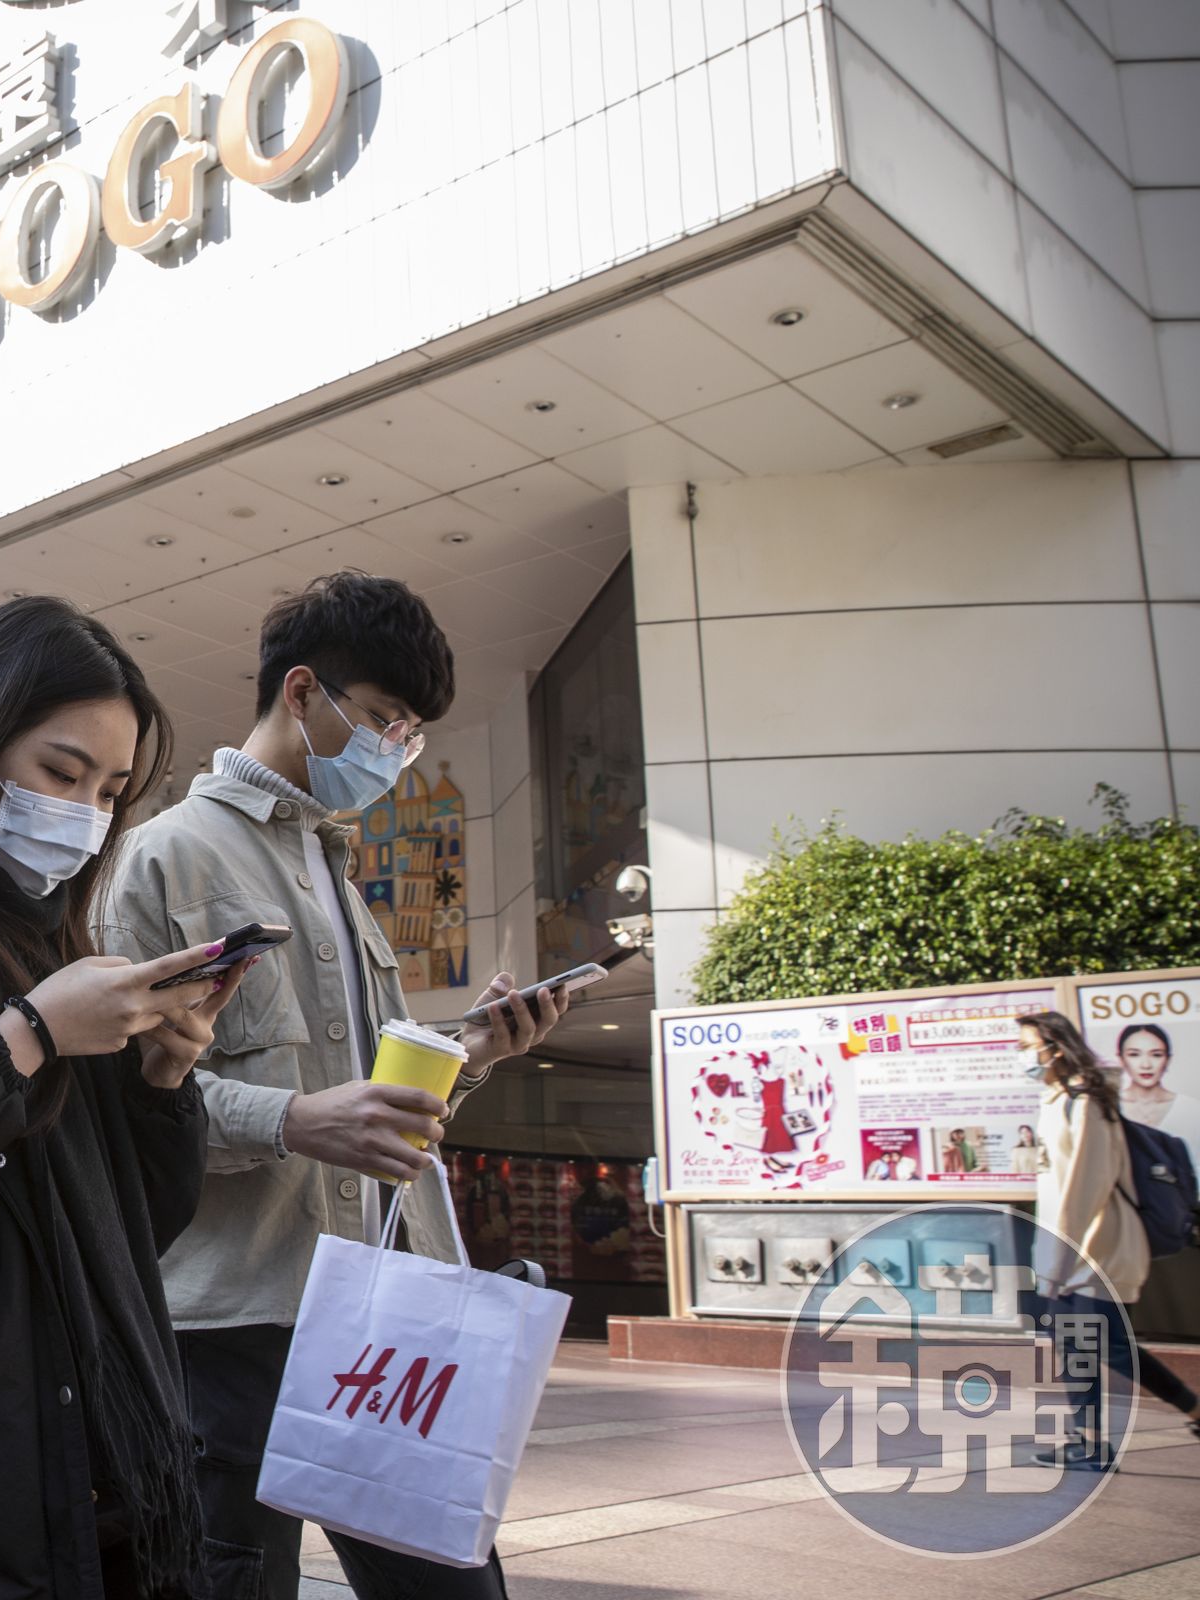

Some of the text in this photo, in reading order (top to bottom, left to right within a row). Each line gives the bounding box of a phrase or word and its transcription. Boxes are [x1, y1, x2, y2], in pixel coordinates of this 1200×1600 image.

[1090, 990, 1190, 1020] SOGO
[672, 1022, 742, 1047] SOGO
[326, 1343, 458, 1439] H&M
